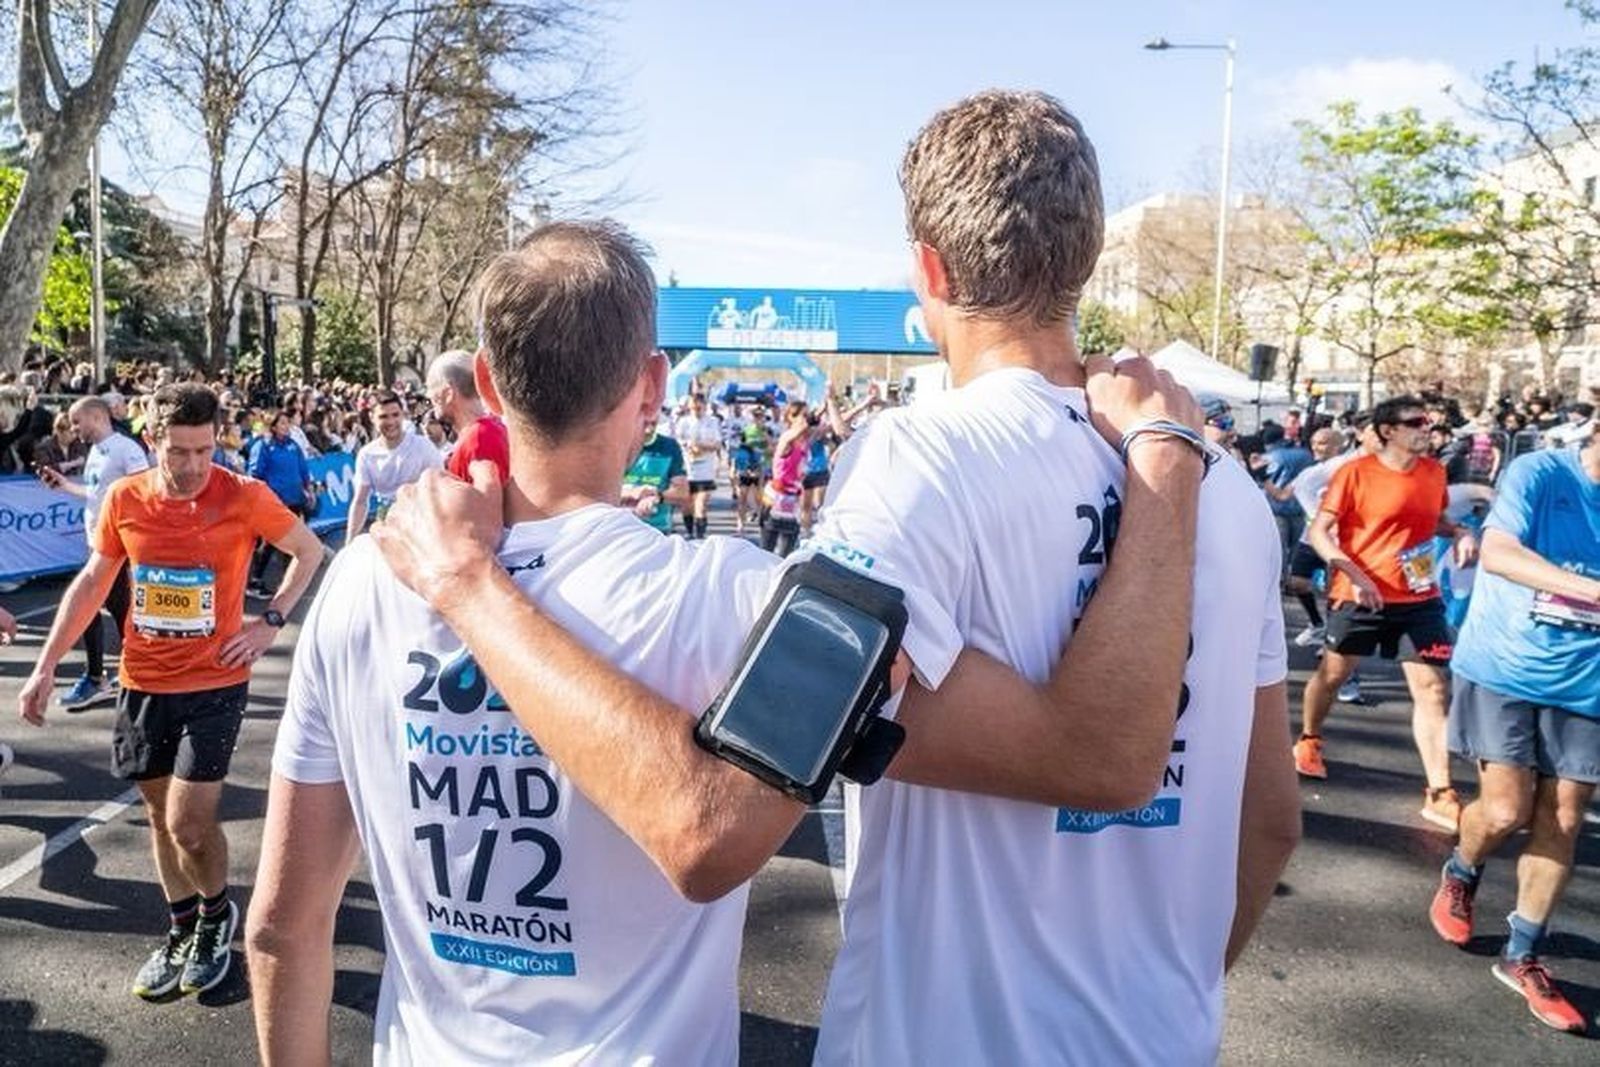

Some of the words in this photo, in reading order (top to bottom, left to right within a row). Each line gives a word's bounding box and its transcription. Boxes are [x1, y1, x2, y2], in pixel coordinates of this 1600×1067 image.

[155, 593, 190, 608] 3600
[406, 722, 544, 757] Movista
[408, 761, 559, 819] MAD
[414, 823, 568, 911] 1/2
[426, 901, 573, 943] MARATÓN
[485, 949, 559, 971] EDICIÓN
